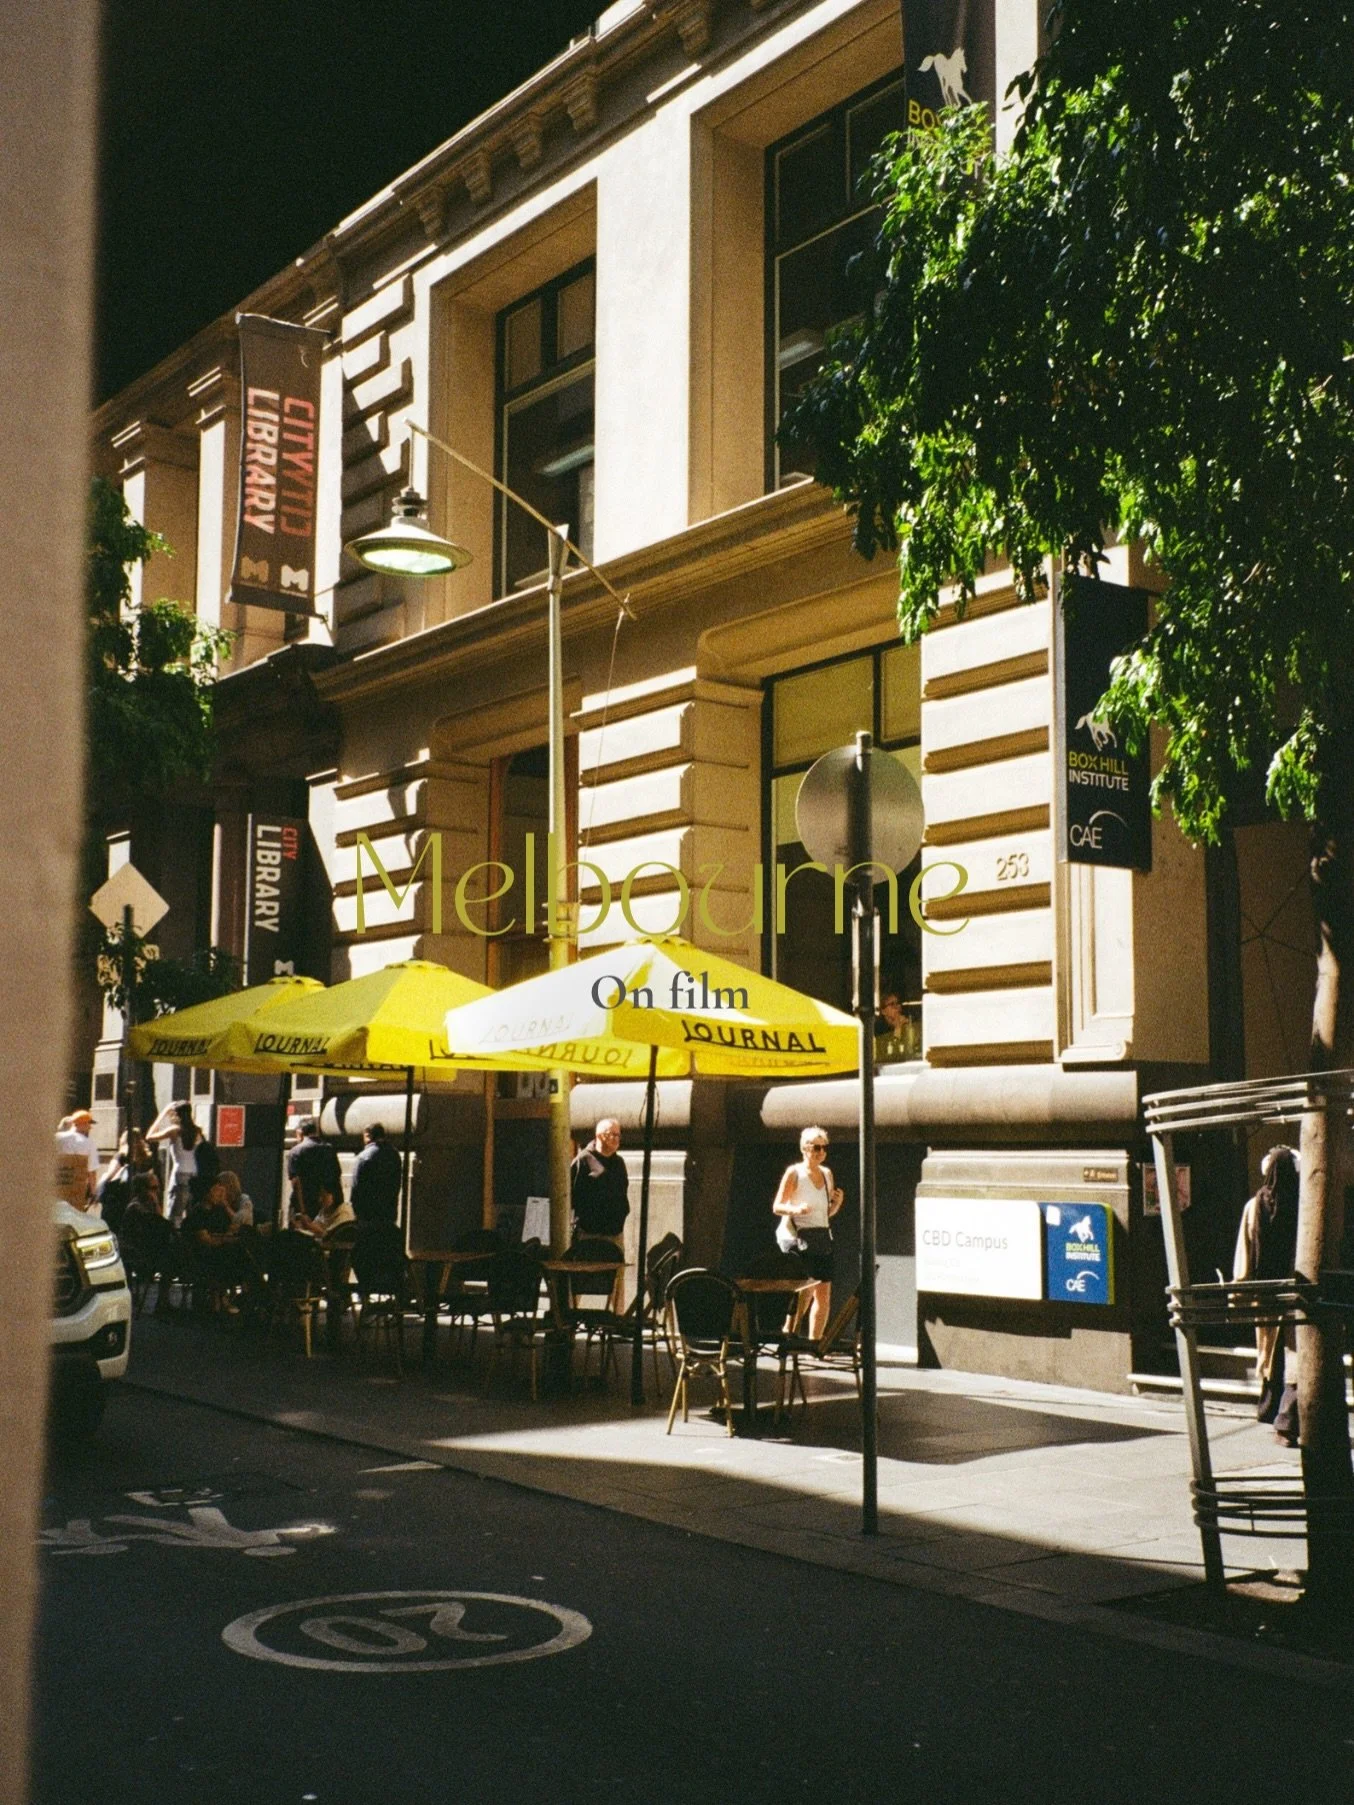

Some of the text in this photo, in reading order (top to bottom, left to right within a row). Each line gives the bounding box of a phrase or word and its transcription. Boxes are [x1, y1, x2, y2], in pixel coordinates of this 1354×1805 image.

[908, 99, 941, 132] BO
[244, 387, 280, 534] LIBRARY
[1068, 751, 1129, 776] BOX HILL
[1068, 769, 1130, 791] INSTITUTE
[283, 826, 298, 860] CITY
[1069, 824, 1103, 849] CAE
[255, 825, 282, 932] LIBRARY
[996, 853, 1030, 881] 253
[253, 1033, 331, 1056] JOURNAL
[681, 1019, 827, 1054] JOURNAL
[922, 1229, 1009, 1252] CBD Campus
[1065, 1278, 1087, 1293] CAE
[300, 1601, 508, 1655] 20
